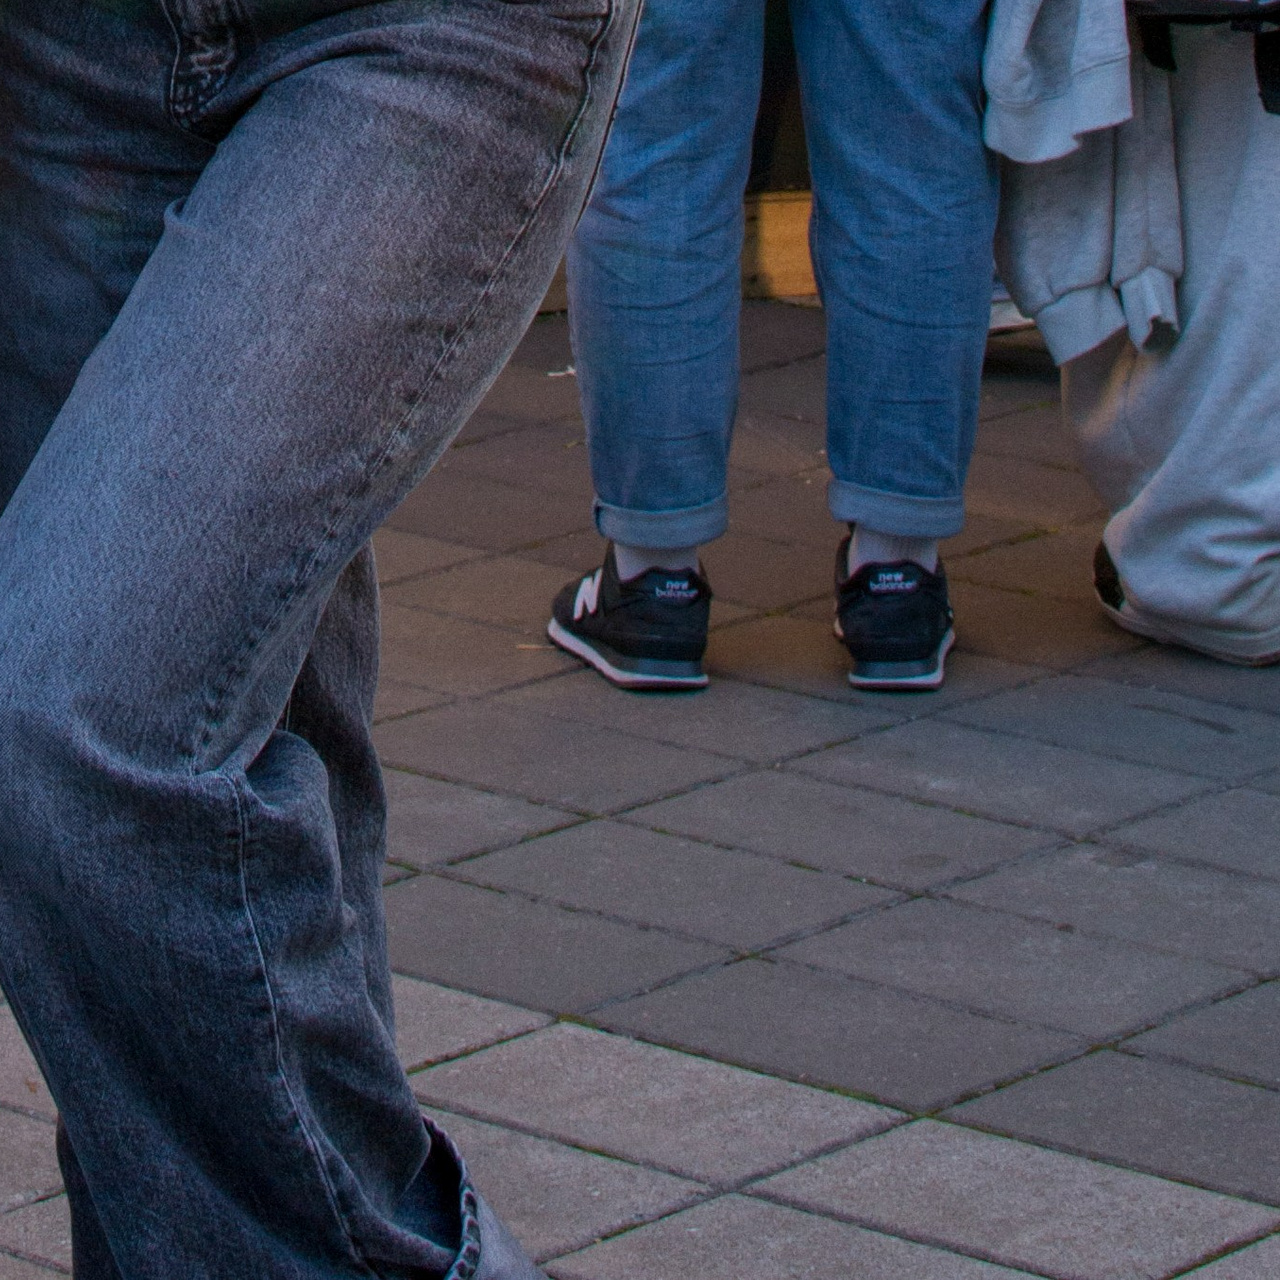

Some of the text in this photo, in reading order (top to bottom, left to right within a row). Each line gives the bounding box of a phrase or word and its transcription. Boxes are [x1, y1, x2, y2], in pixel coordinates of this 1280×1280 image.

[878, 571, 904, 582] new
[665, 580, 689, 590] new
[869, 580, 917, 592] balance
[573, 567, 602, 620] N
